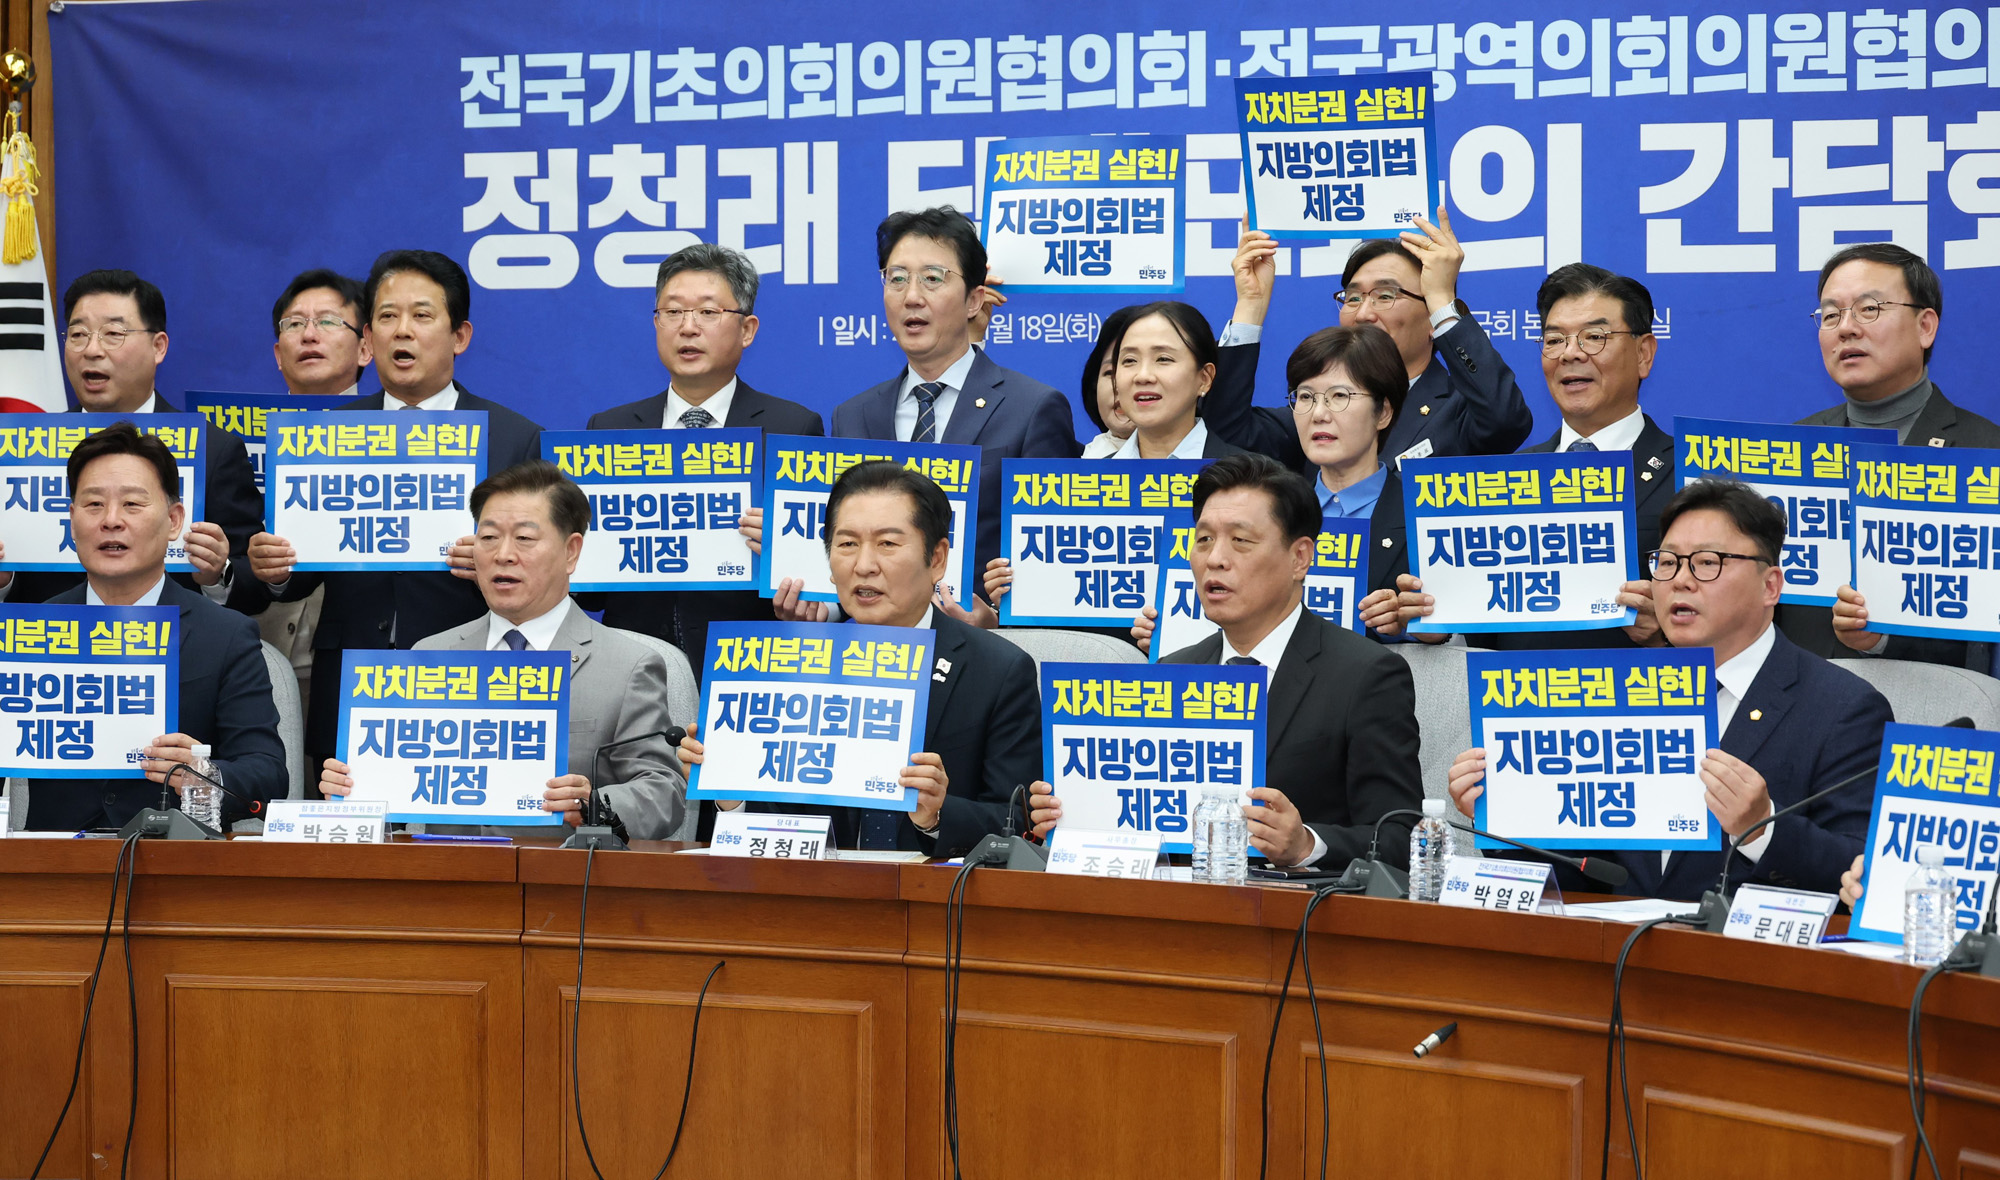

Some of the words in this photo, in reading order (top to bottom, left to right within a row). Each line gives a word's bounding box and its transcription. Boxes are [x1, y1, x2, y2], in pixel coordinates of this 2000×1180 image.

[1245, 90, 1347, 124] 자치분권
[1355, 87, 1426, 122] 실현!
[994, 150, 1100, 182] 자치분권
[1108, 149, 1179, 181] 실현!
[1256, 138, 1417, 180] 지방의회법
[463, 142, 838, 290] 정청래
[996, 198, 1165, 235] 지방의회법
[1302, 183, 1366, 222] 제정
[1045, 240, 1112, 277] 제정
[1139, 269, 1166, 279] 민주당
[832, 315, 877, 345] 일시
[1018, 312, 1102, 343] 18일(화)
[0, 427, 106, 458] 자치분
[136, 427, 199, 459] 현!
[277, 425, 397, 457] 자치분권
[405, 424, 481, 457] 실현!
[553, 443, 673, 477] 자치분권
[681, 441, 754, 476] 실현!
[1684, 434, 1802, 477] 자치분권
[284, 473, 465, 512] 지방의회법
[1013, 474, 1131, 507] 자치분권
[1414, 469, 1542, 508] 자치분권
[1549, 466, 1625, 504] 실현!
[1856, 461, 1957, 503] 자치분권
[164, 548, 186, 559] 주당
[339, 516, 411, 554] 제정
[1021, 525, 1163, 566] 지방의회
[1310, 532, 1362, 568] 현!
[1426, 523, 1616, 568] 지방의회법
[619, 536, 689, 574] 제정
[717, 565, 746, 576] 민주당
[1778, 544, 1819, 586] 정
[1075, 570, 1146, 609] 제정
[1487, 570, 1561, 613] 제정
[1591, 603, 1619, 614] 민주당
[1901, 572, 1969, 619] 제정
[89, 620, 171, 656] 실현!
[714, 636, 833, 675] 자치분권
[841, 639, 926, 681] 실현!
[353, 666, 478, 701] 자치분권
[488, 666, 563, 701] 실현!
[1052, 679, 1173, 719] 자치분권
[1181, 681, 1259, 721] 실현!
[1481, 667, 1616, 708] 자치분권
[1624, 665, 1707, 707] 실현!
[714, 692, 903, 741] 지방의회법
[16, 719, 94, 761] 제정
[126, 752, 157, 764] 민주
[358, 718, 547, 761] 지방의회법
[1494, 727, 1696, 776] 지방의회법
[758, 740, 836, 785] 제정
[1063, 737, 1242, 785] 지방의회법
[1886, 743, 1996, 796] 자치분권
[411, 765, 488, 806] 제정
[865, 780, 898, 793] 민주당
[1557, 781, 1636, 828] 제정
[268, 822, 296, 833] 민주당
[1117, 787, 1189, 833] 제정
[1668, 819, 1700, 833] 민주당
[716, 834, 743, 845] 민주당
